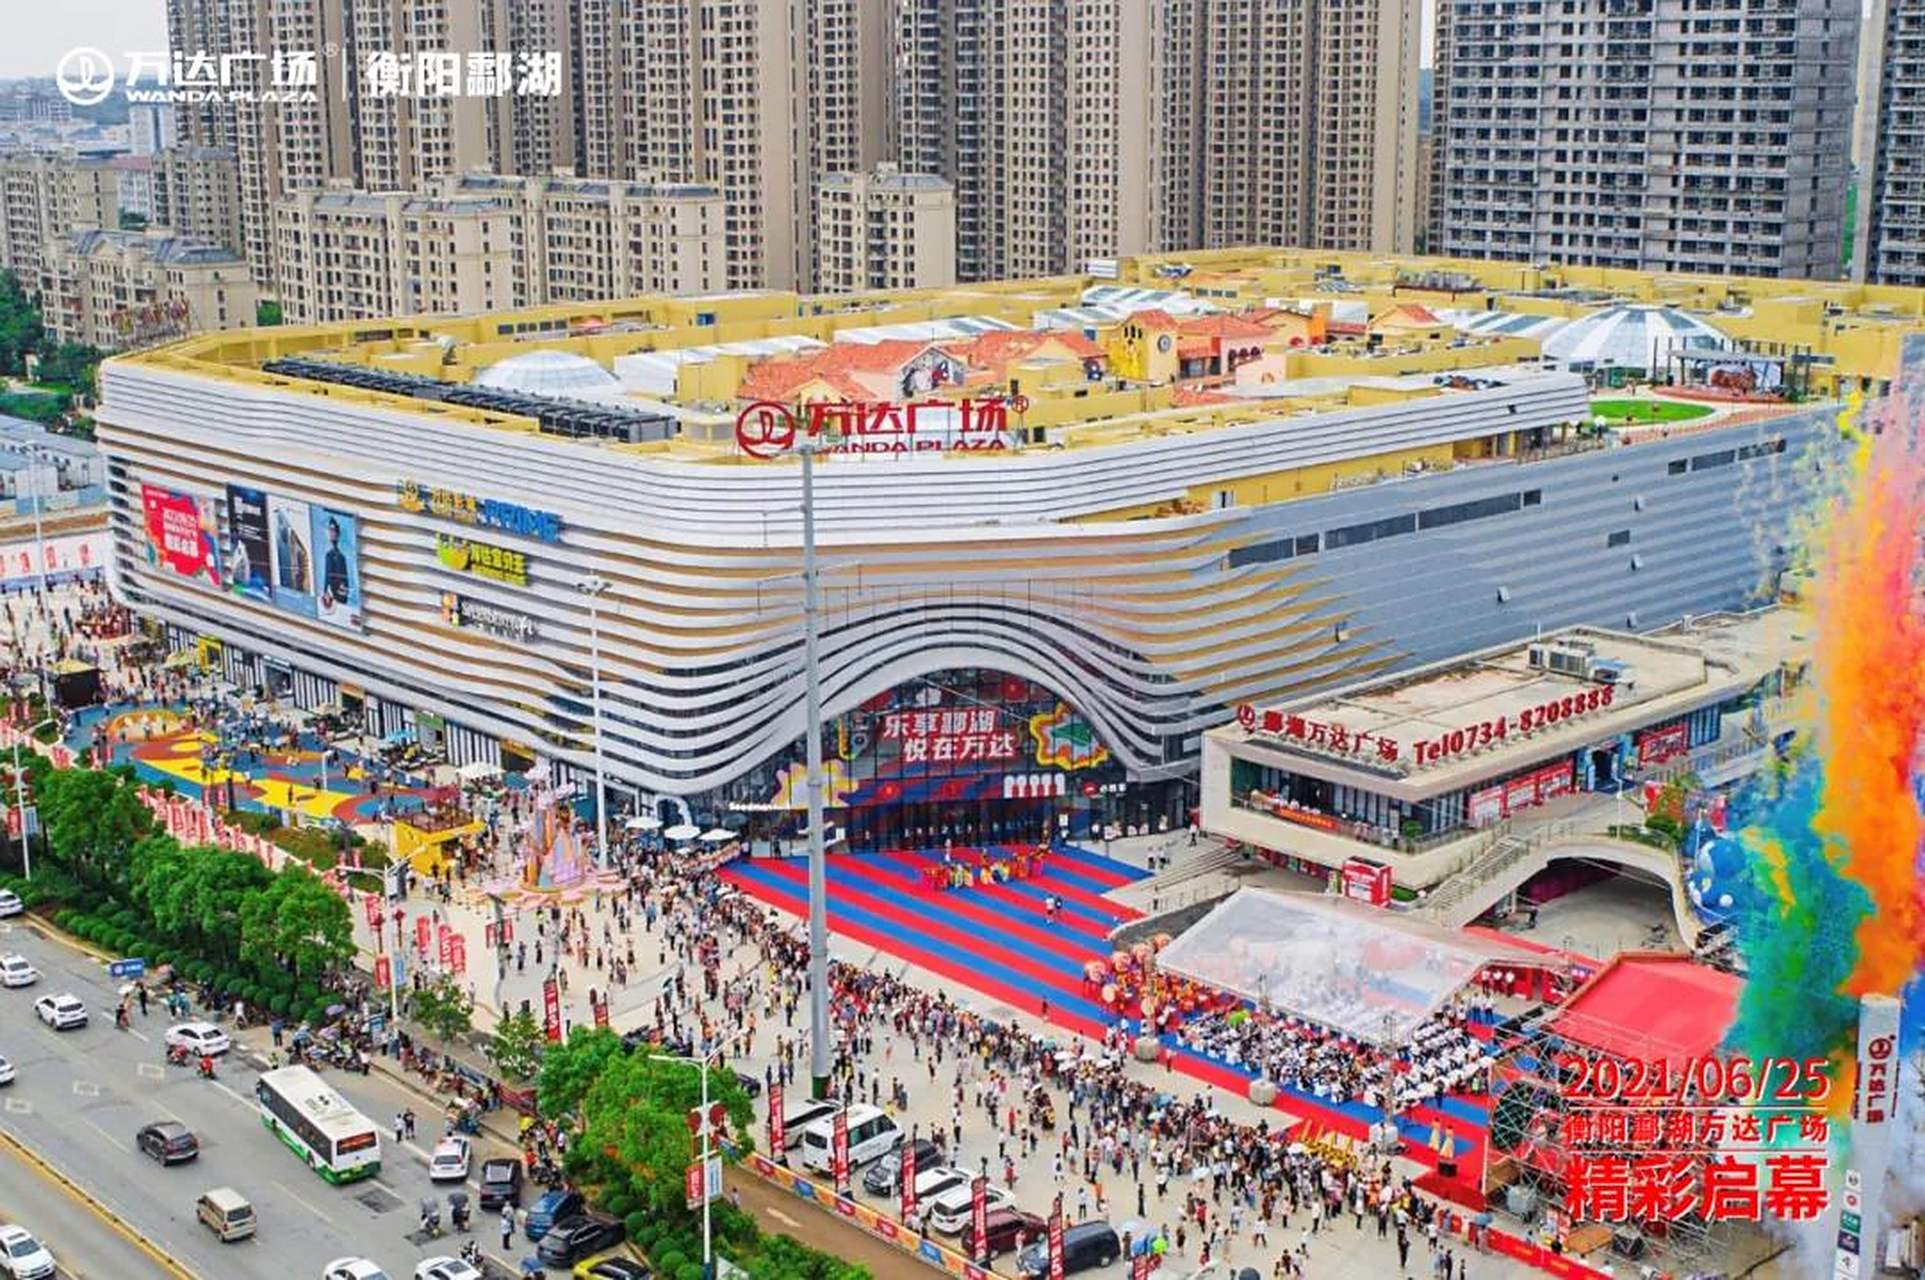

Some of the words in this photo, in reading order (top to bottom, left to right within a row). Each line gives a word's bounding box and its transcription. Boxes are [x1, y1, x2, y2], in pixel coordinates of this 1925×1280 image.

[804, 398, 1008, 437] 万达广场
[904, 734, 1016, 762] 悦在万达
